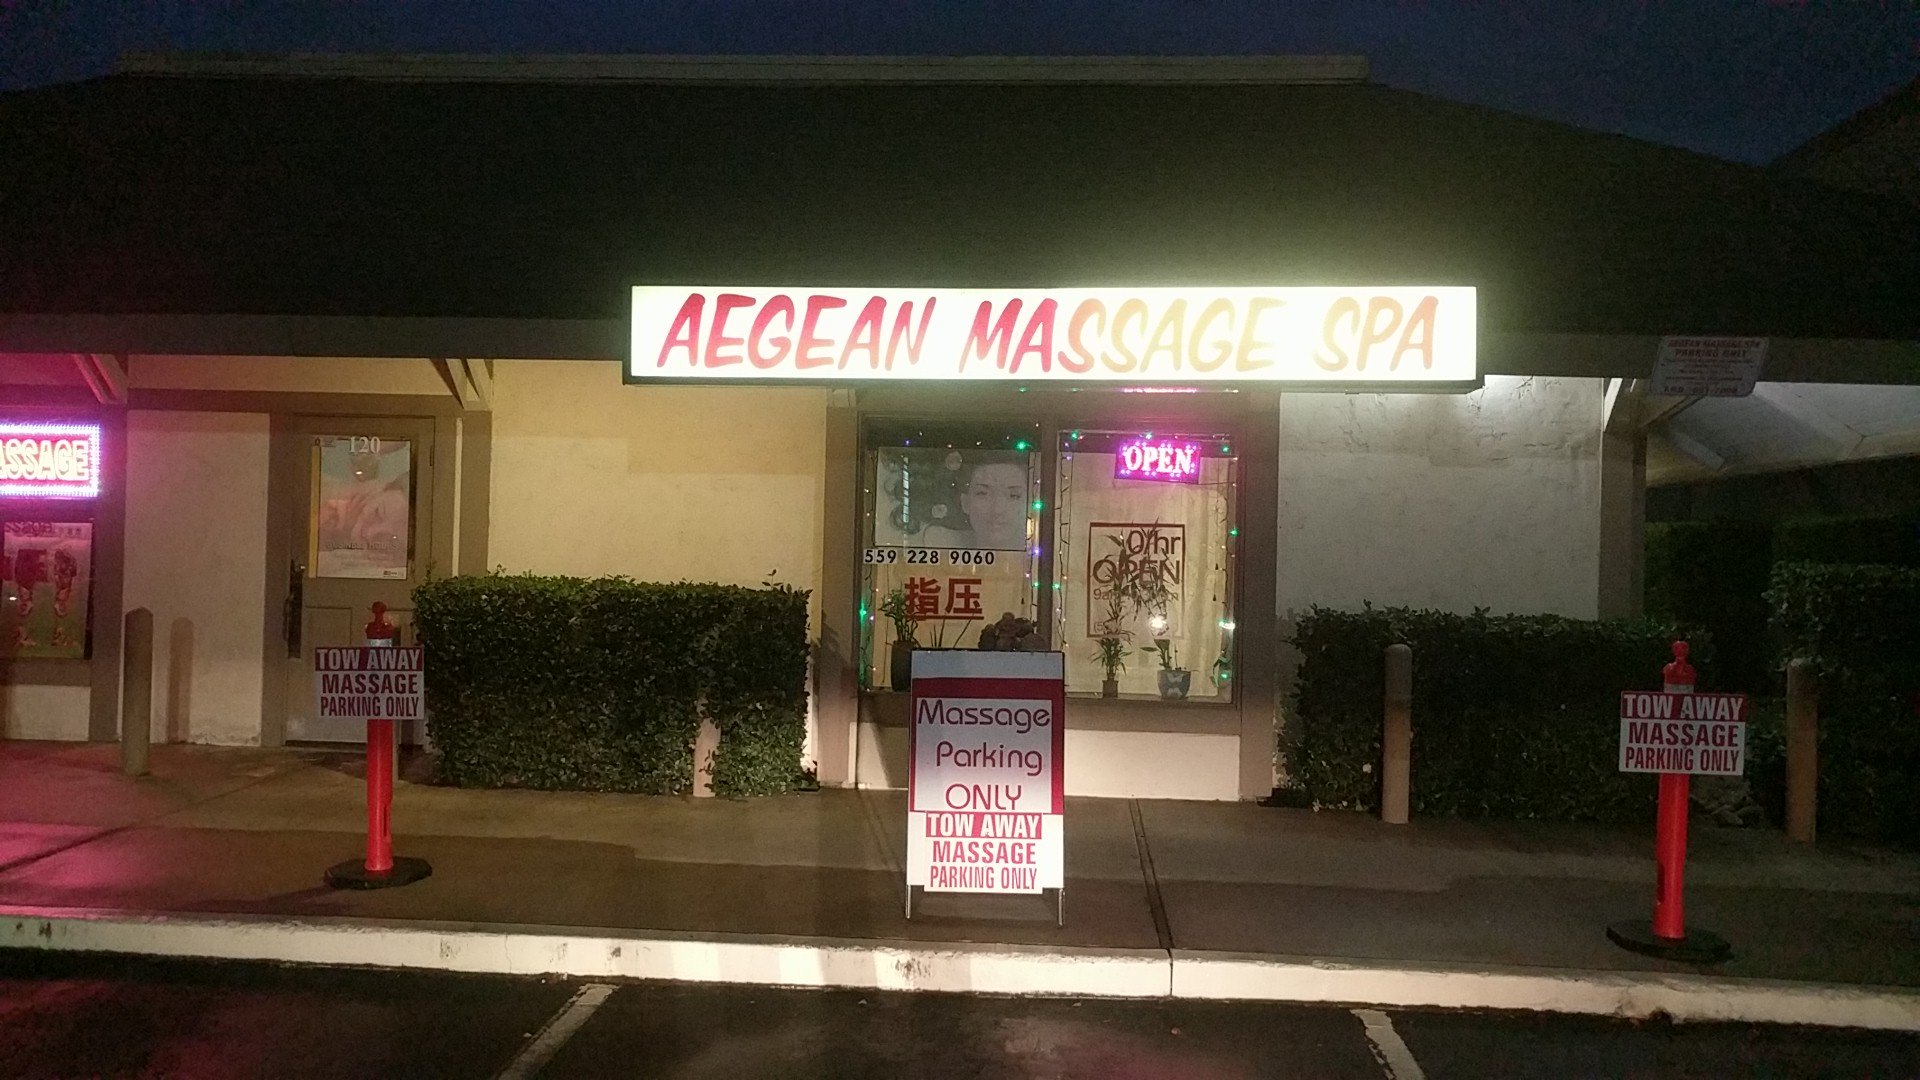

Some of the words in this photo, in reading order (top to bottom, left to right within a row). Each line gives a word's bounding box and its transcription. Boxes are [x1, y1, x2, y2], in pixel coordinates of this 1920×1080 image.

[657, 293, 936, 370] AEGEAN
[958, 296, 1287, 373] MASSAGE
[1314, 295, 1438, 371] SPA
[349, 436, 380, 453] 120
[1123, 446, 1194, 474] OPEN
[864, 550, 897, 563] 559
[907, 550, 939, 564] 228
[950, 551, 995, 564] 9060
[903, 577, 983, 616] 指压
[317, 649, 361, 670] TOW
[366, 649, 420, 670] AWAY
[322, 674, 418, 694] MASSAGE
[320, 696, 381, 717] PARKING
[386, 696, 419, 717] ONLY
[917, 699, 1051, 734] Massage
[1623, 694, 1673, 718] TOW
[1680, 696, 1743, 720] AWAY
[1628, 722, 1739, 747] MASSAGE
[936, 740, 1043, 776] Parking
[1625, 746, 1694, 771] PARKING
[1700, 749, 1739, 772] ONLY
[945, 783, 1022, 810] ONLY
[928, 813, 975, 837] TOW
[980, 814, 1040, 838] AWAY
[932, 840, 1036, 865] MASSAGE
[930, 866, 995, 888] PARKING
[1001, 867, 1038, 890] ONLY
